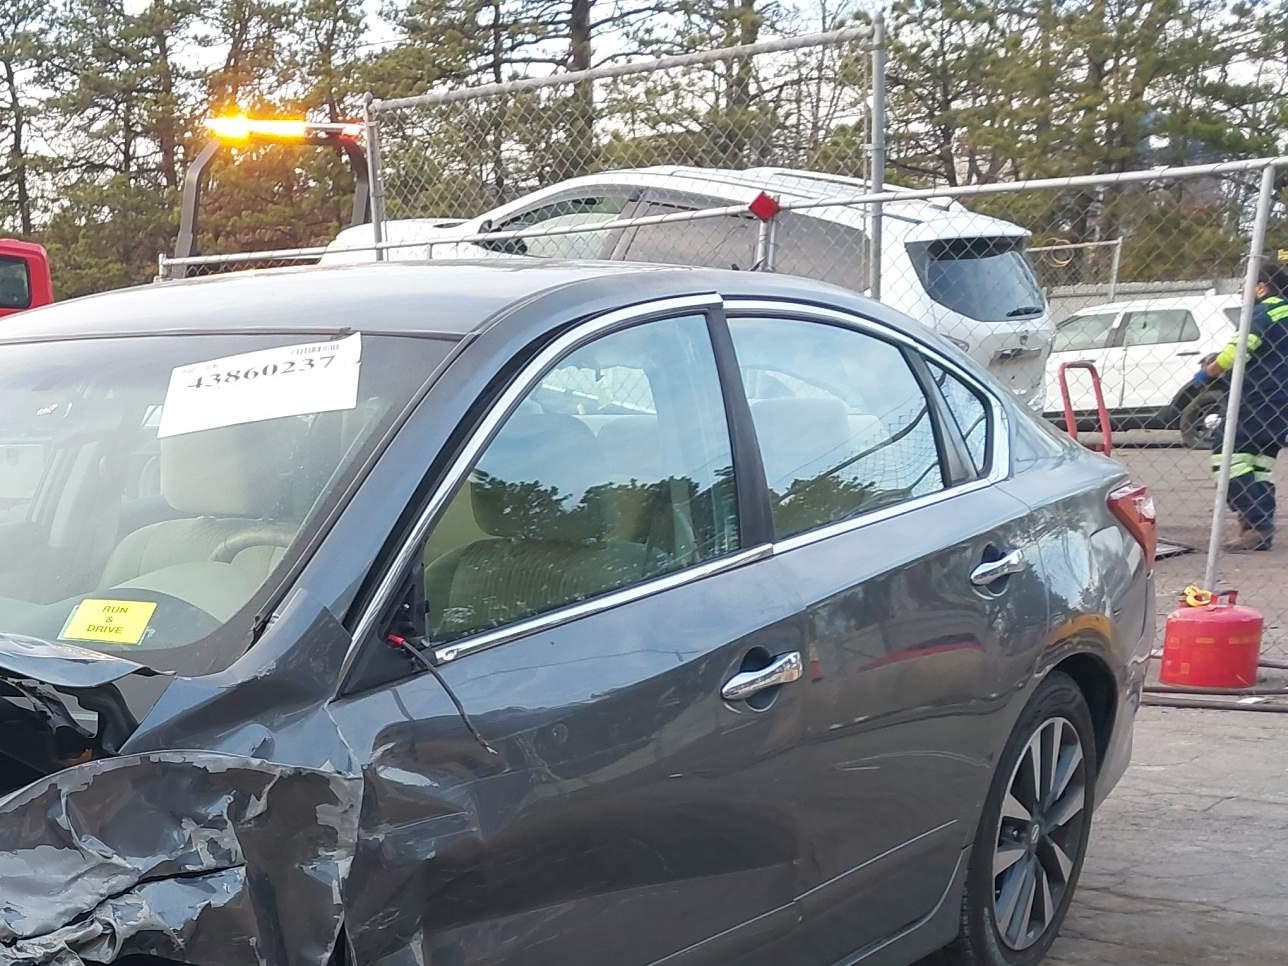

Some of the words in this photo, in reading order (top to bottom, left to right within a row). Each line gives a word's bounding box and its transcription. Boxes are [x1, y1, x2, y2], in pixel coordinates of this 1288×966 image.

[187, 355, 336, 389] 43860237
[102, 605, 129, 614] RUN
[86, 624, 124, 634] DRIVE
